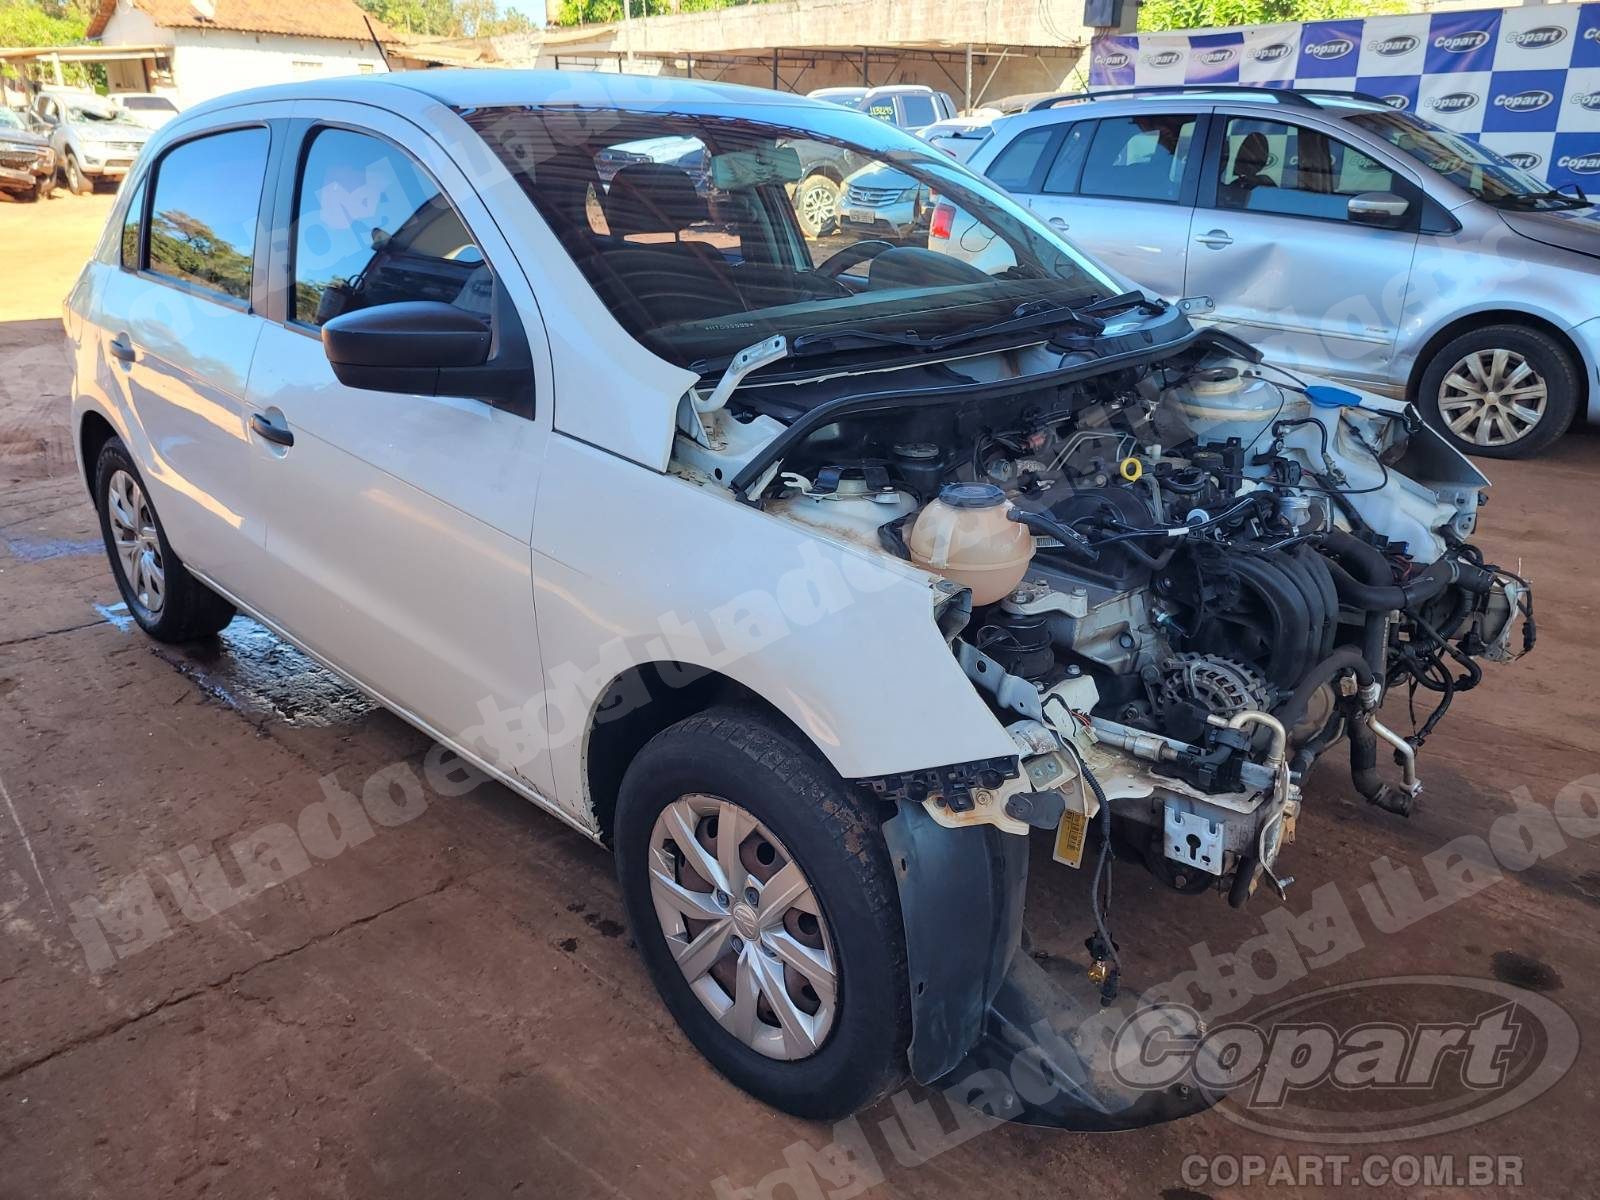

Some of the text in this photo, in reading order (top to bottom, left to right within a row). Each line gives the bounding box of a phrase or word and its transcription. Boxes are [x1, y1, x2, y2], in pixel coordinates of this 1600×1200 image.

[1434, 33, 1483, 49] Copart
[1506, 28, 1559, 44] Copart
[1247, 44, 1287, 60] Copart
[1305, 40, 1347, 55] Copart
[1368, 37, 1413, 52] Copart
[1095, 53, 1126, 66] Copart
[1424, 94, 1471, 109] Copart
[1493, 93, 1547, 109] Copart
[1572, 92, 1600, 107] Cop
